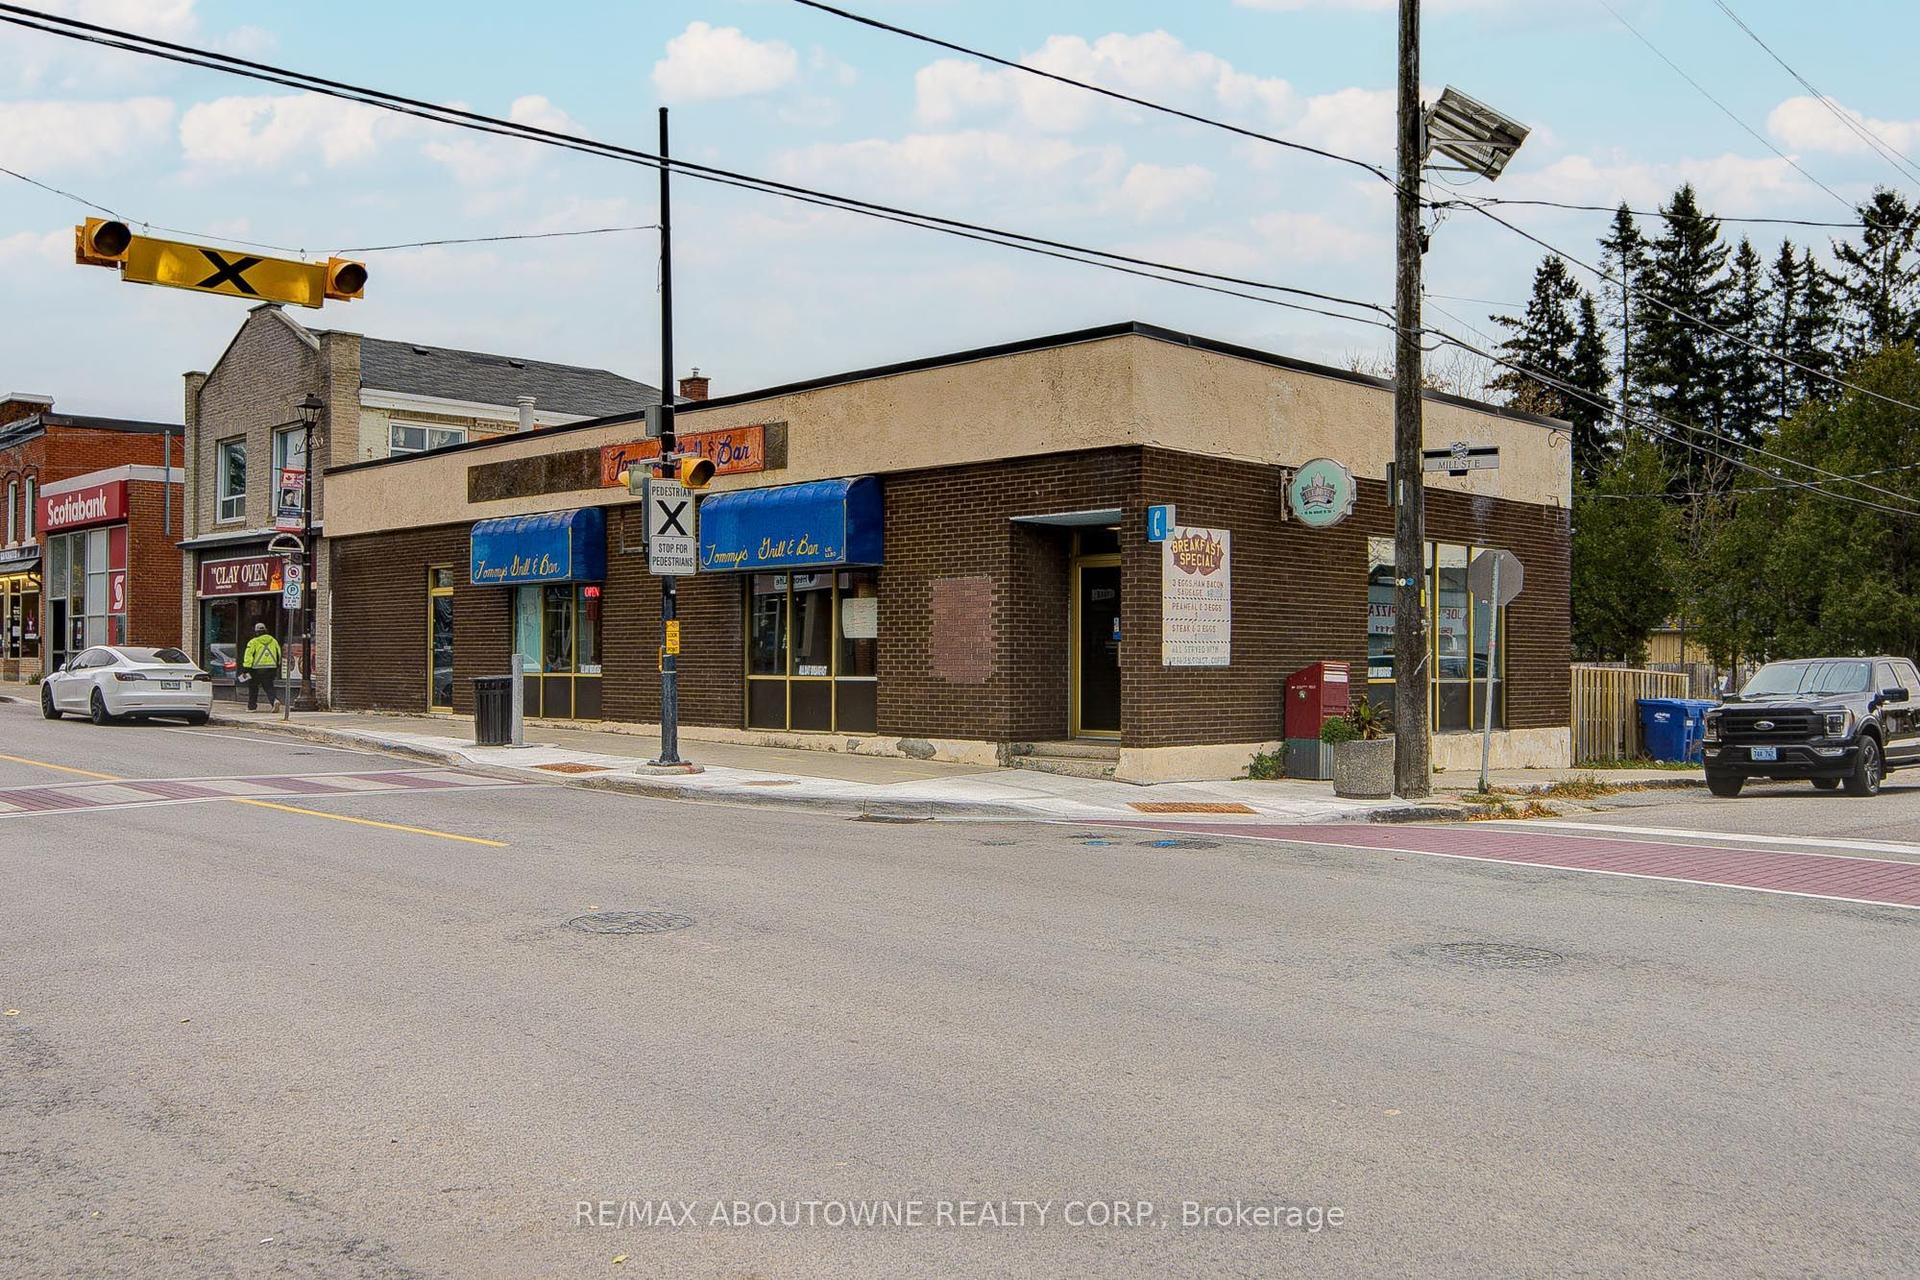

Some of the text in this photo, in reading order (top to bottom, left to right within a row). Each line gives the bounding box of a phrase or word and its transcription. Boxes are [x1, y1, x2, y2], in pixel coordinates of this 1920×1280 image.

[717, 435, 751, 467] Bar
[1438, 459, 1481, 469] MILL ST E
[651, 486, 692, 498] PEDESTRIAN
[47, 488, 107, 526] Scotiabank
[658, 543, 688, 554] STOP FOR
[796, 533, 819, 556] Bar
[1172, 538, 1221, 557] BREAKFAST
[540, 553, 560, 576] Bar
[652, 556, 693, 568] PEDESTRIANS
[1180, 553, 1215, 567] SPECIAL
[215, 565, 240, 585] CLAY
[241, 562, 269, 583] OVEN
[1206, 580, 1224, 589] BACON
[584, 586, 600, 598] OPEN
[1177, 588, 1202, 597] SAUSAGE
[1172, 602, 1198, 611] PEAMEAL
[1208, 603, 1222, 613] EGGS
[1171, 624, 1190, 633] STEAK
[1202, 624, 1216, 633] EGGS
